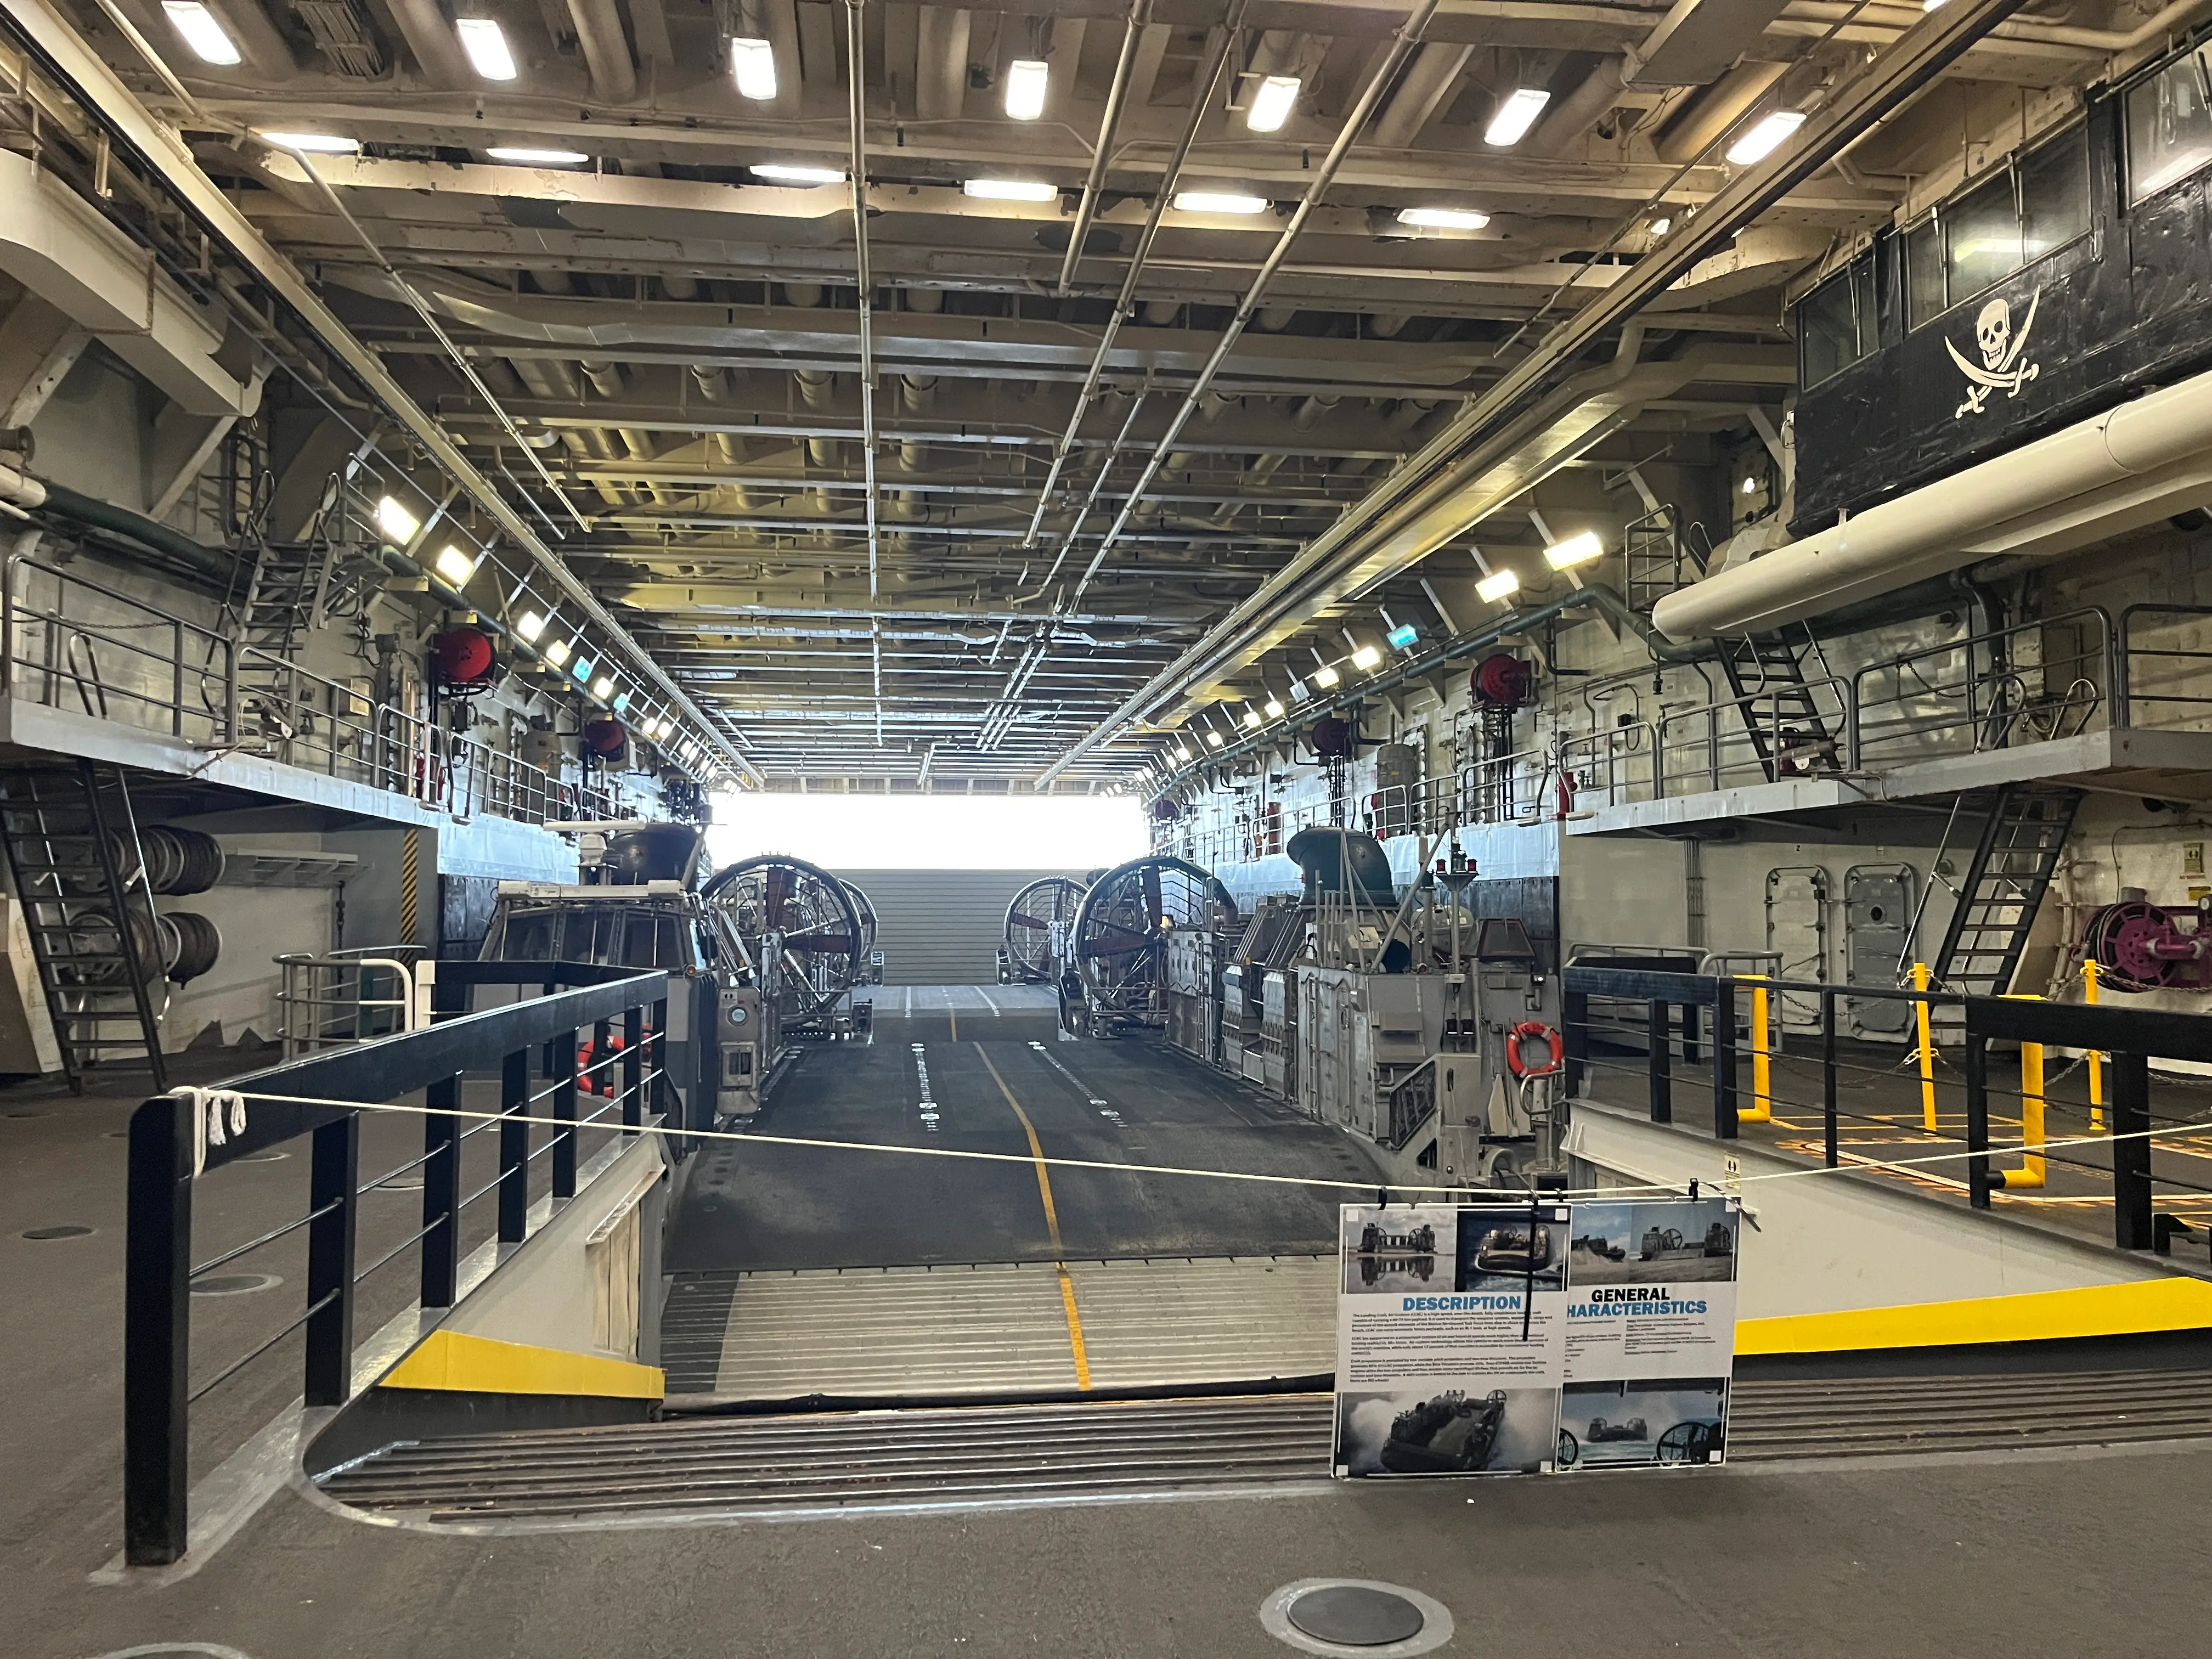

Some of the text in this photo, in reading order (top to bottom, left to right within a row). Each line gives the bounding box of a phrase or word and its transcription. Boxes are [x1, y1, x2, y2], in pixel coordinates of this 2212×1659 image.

[1591, 1288, 1670, 1302] GENERAL
[1403, 1296, 1521, 1311] DESCRIPTION
[1567, 1300, 1707, 1318] HARACTERISTICS
